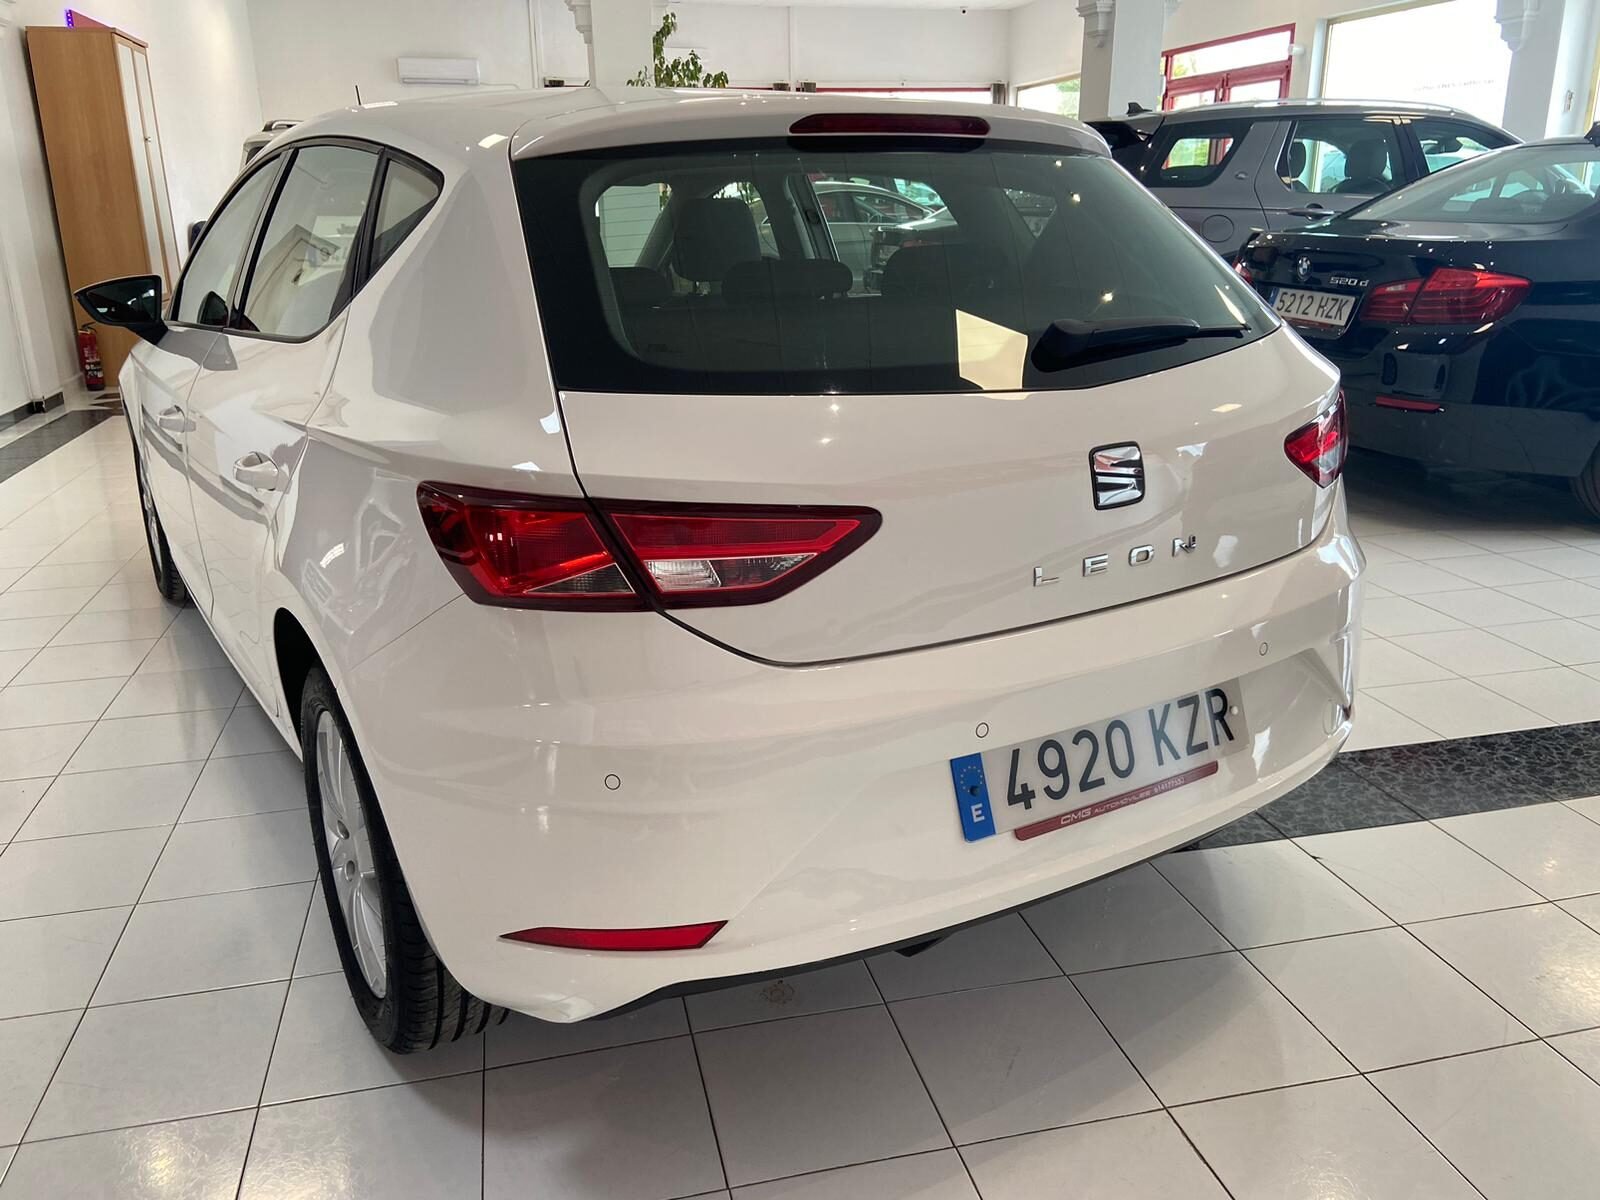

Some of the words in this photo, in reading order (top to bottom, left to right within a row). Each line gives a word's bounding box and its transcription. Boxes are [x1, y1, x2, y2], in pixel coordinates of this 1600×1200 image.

[1329, 276, 1358, 286] 520
[1276, 292, 1314, 316] 5212
[1315, 296, 1349, 320] HZK
[1033, 535, 1197, 587] LEON
[1006, 719, 1135, 810] 4920
[1148, 688, 1235, 766] KZR
[970, 803, 985, 823] E
[1061, 807, 1092, 825] CMG
[1094, 789, 1151, 814] AUTOMOVILES
